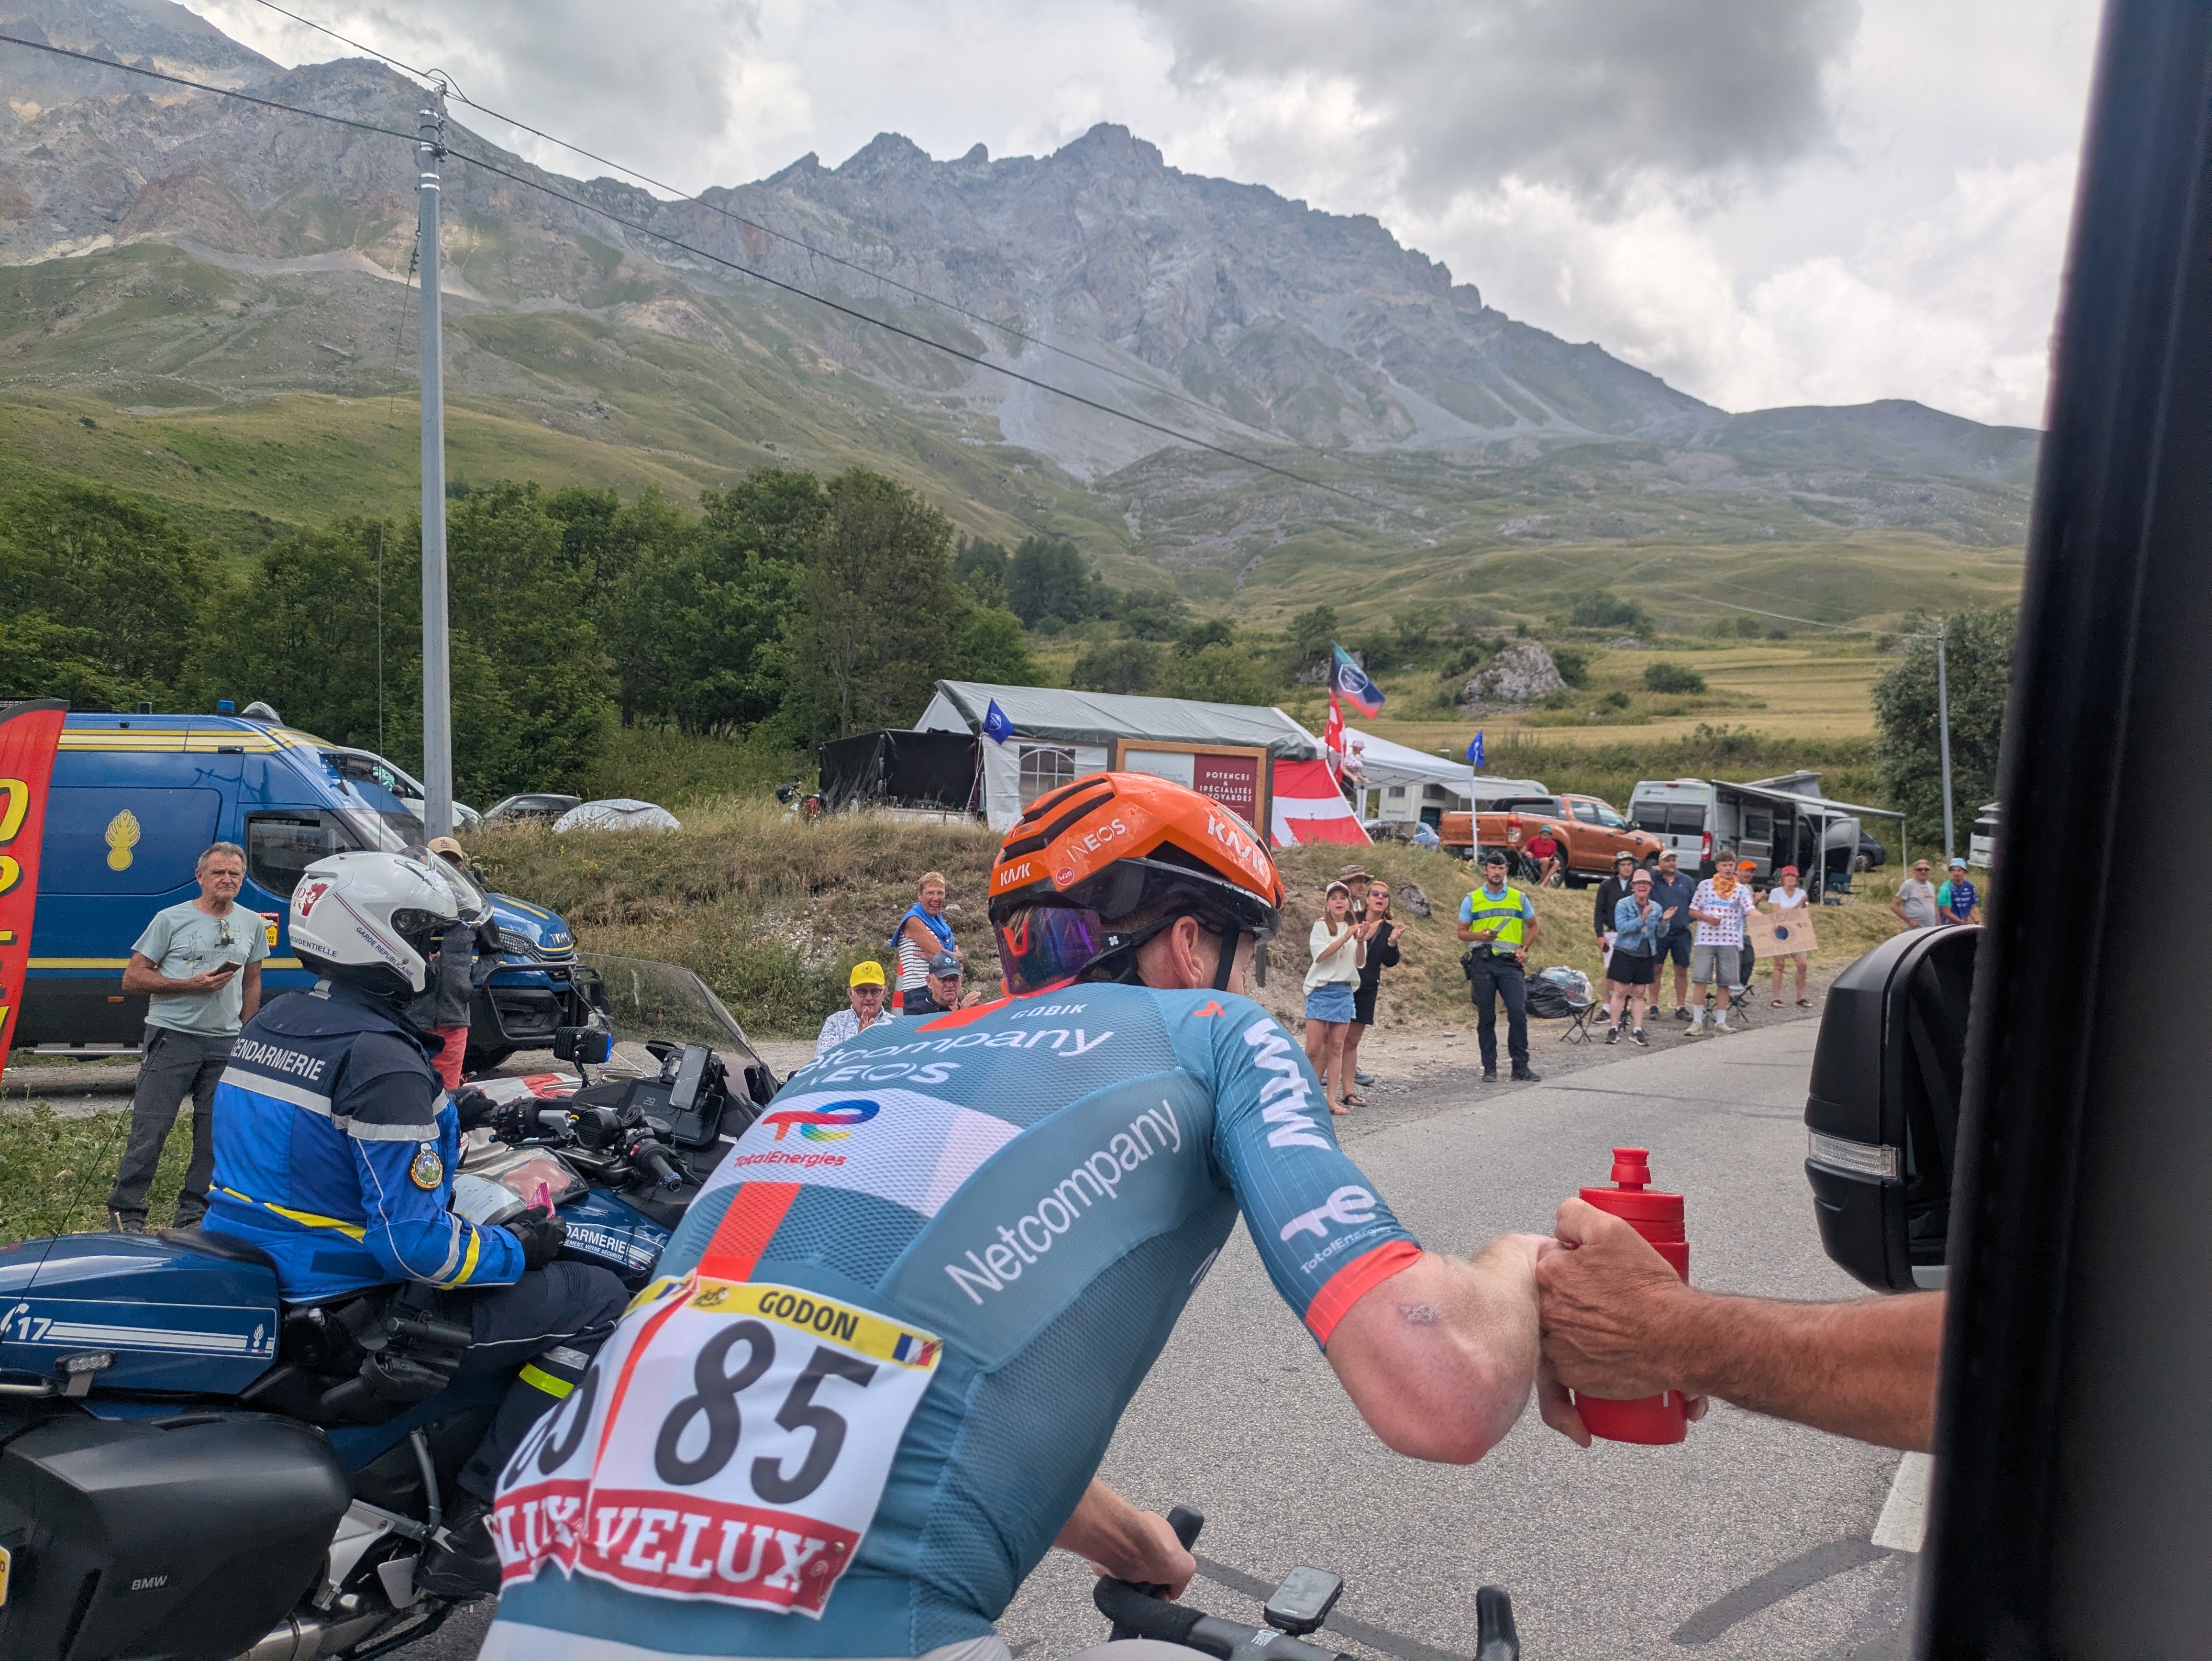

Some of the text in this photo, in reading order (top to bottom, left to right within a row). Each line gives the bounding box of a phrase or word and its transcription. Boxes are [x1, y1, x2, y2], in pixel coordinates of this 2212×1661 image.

[1206, 771, 1250, 780] POTENCES
[1199, 785, 1252, 794] SPÉCIALITÉS
[1203, 793, 1252, 802] VOYARDES
[1066, 818, 1126, 863] INEOS
[1207, 815, 1265, 878] KASK
[1000, 862, 1030, 886] KASK
[356, 927, 414, 978] GARDE REPUBLICAINE
[1010, 1004, 1089, 1019] GOBIK
[230, 1038, 326, 1081] GENDARMERIE
[794, 1028, 1114, 1077] etcompany
[643, 1096, 656, 1106] 29
[734, 1150, 847, 1169] TotalEnergies
[944, 1098, 1181, 1306] Netcompany
[585, 1244, 600, 1253] VOTRE
[600, 1249, 623, 1261] SÉCURITÉ
[759, 1291, 860, 1341] GODON
[18, 1317, 52, 1340] 17
[654, 1319, 880, 1504] 85
[595, 1506, 827, 1592] VELUX
[131, 1575, 168, 1590] BMW
